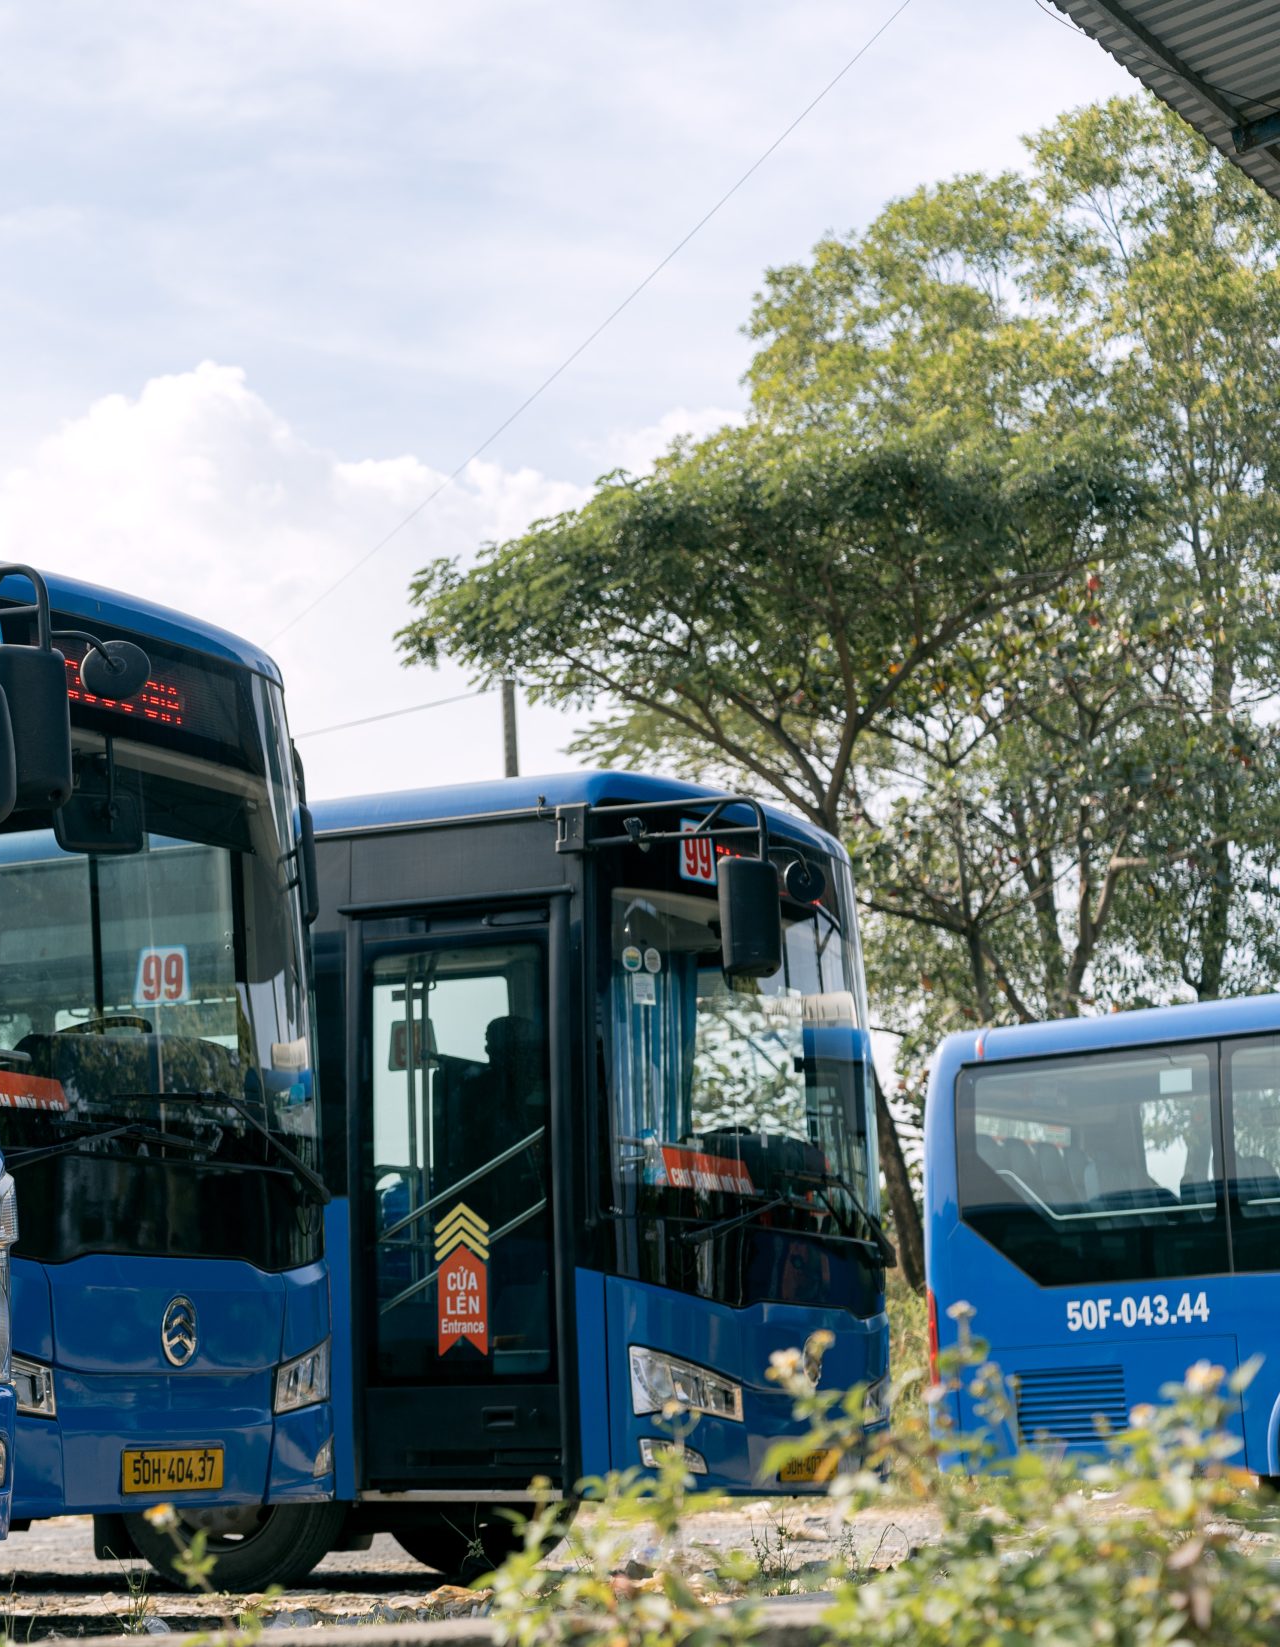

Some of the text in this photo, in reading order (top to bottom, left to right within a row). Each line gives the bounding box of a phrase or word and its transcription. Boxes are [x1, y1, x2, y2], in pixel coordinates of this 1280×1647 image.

[142, 952, 184, 1001] 99
[447, 1265, 478, 1291] CỬA
[446, 1291, 480, 1315] LÊN
[1066, 1291, 1210, 1332] 50F-043.44
[441, 1318, 485, 1335] Entrance
[132, 1456, 215, 1485] 50H-404.37
